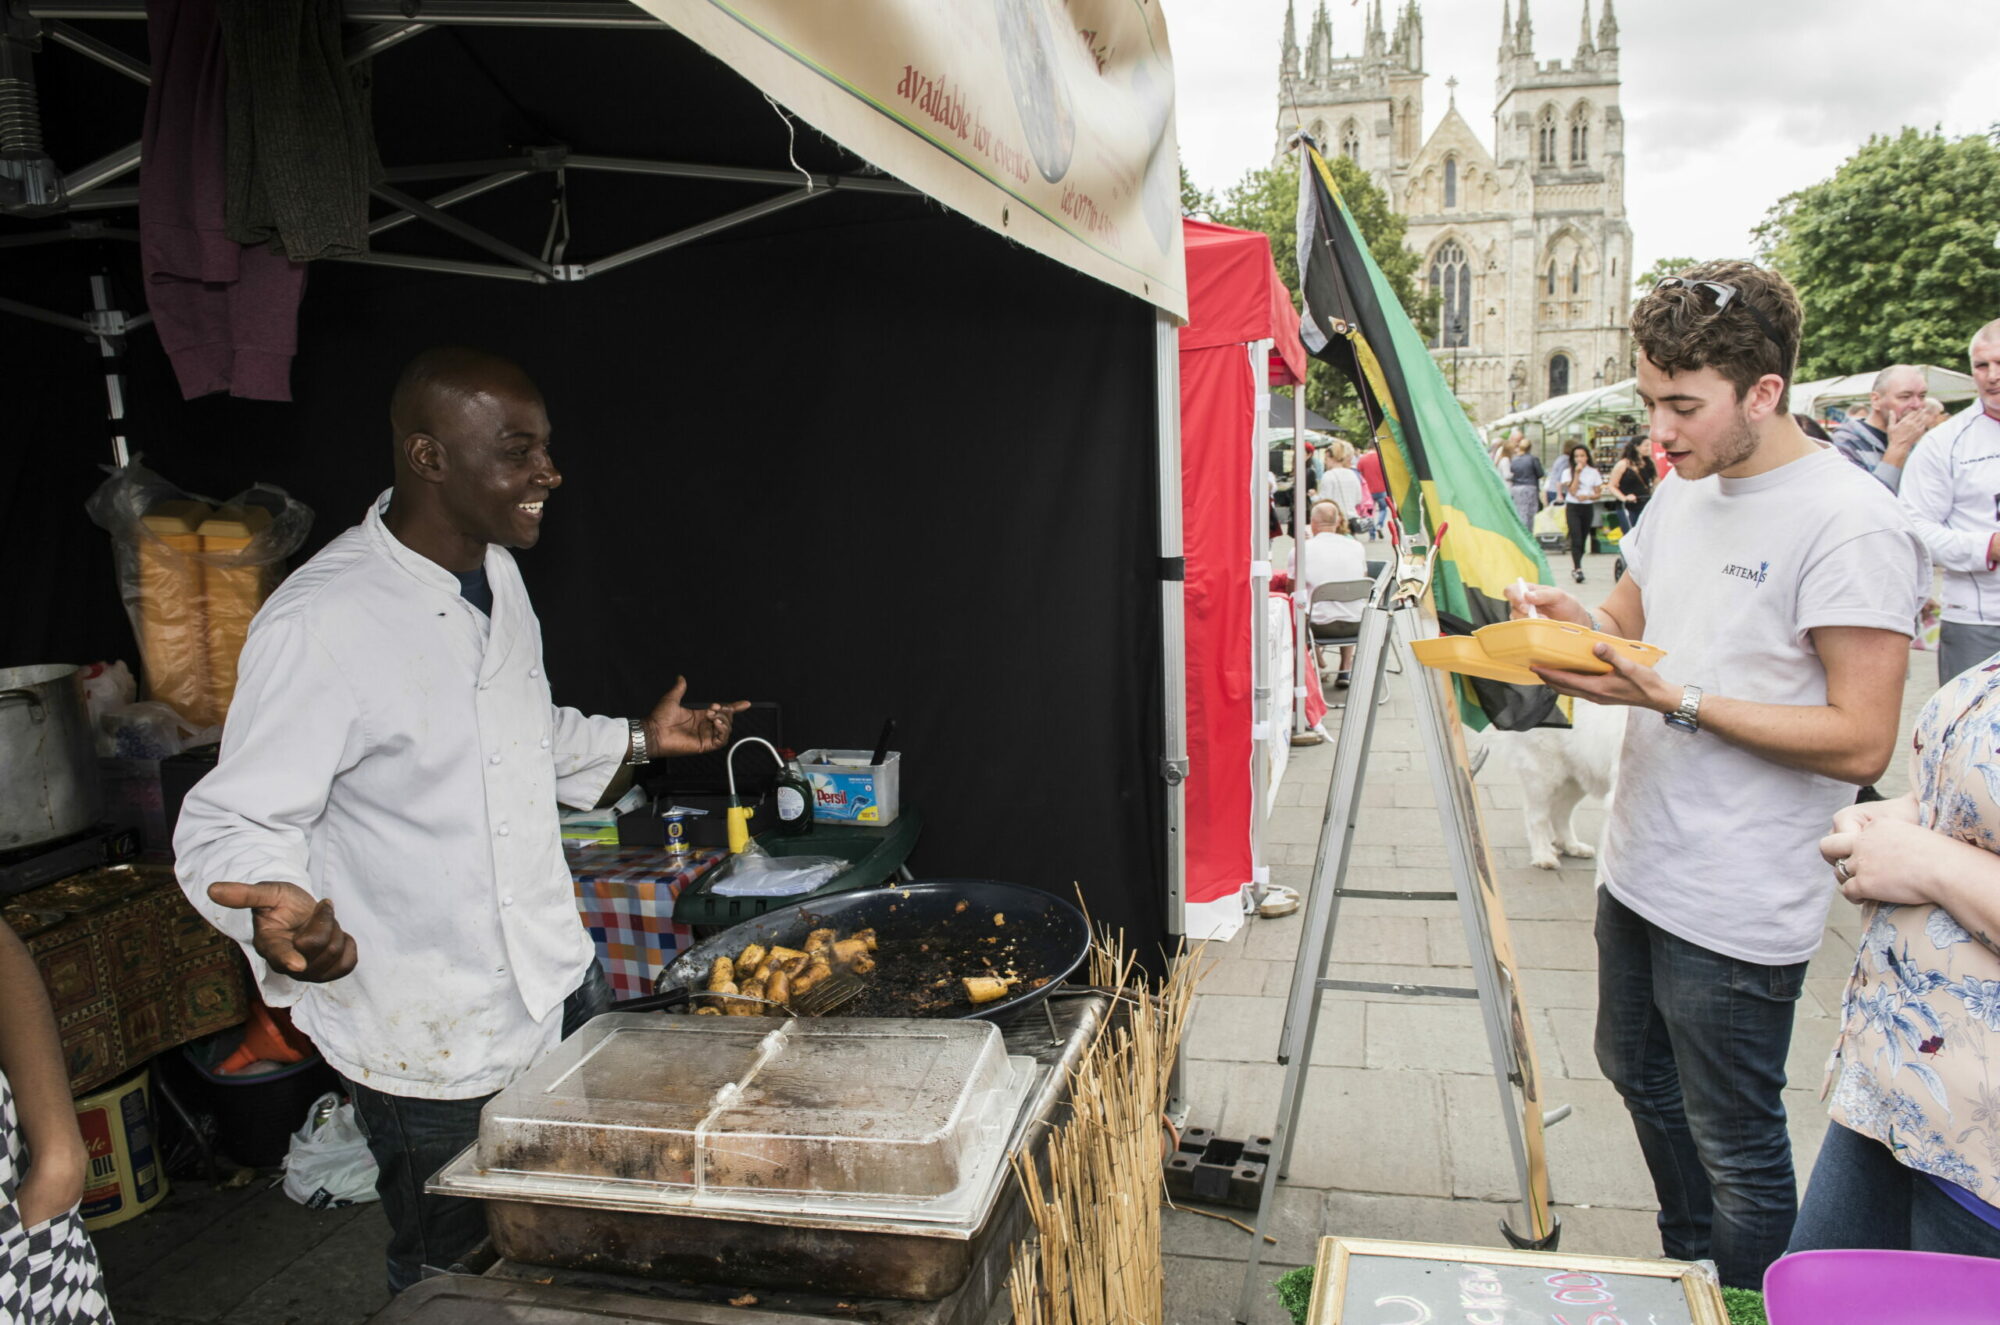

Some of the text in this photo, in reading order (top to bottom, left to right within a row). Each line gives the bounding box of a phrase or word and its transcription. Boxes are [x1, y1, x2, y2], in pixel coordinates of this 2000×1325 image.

[897, 65, 1031, 184] available for events
[817, 789, 848, 806] Persil
[93, 1154, 115, 1176] OIL
